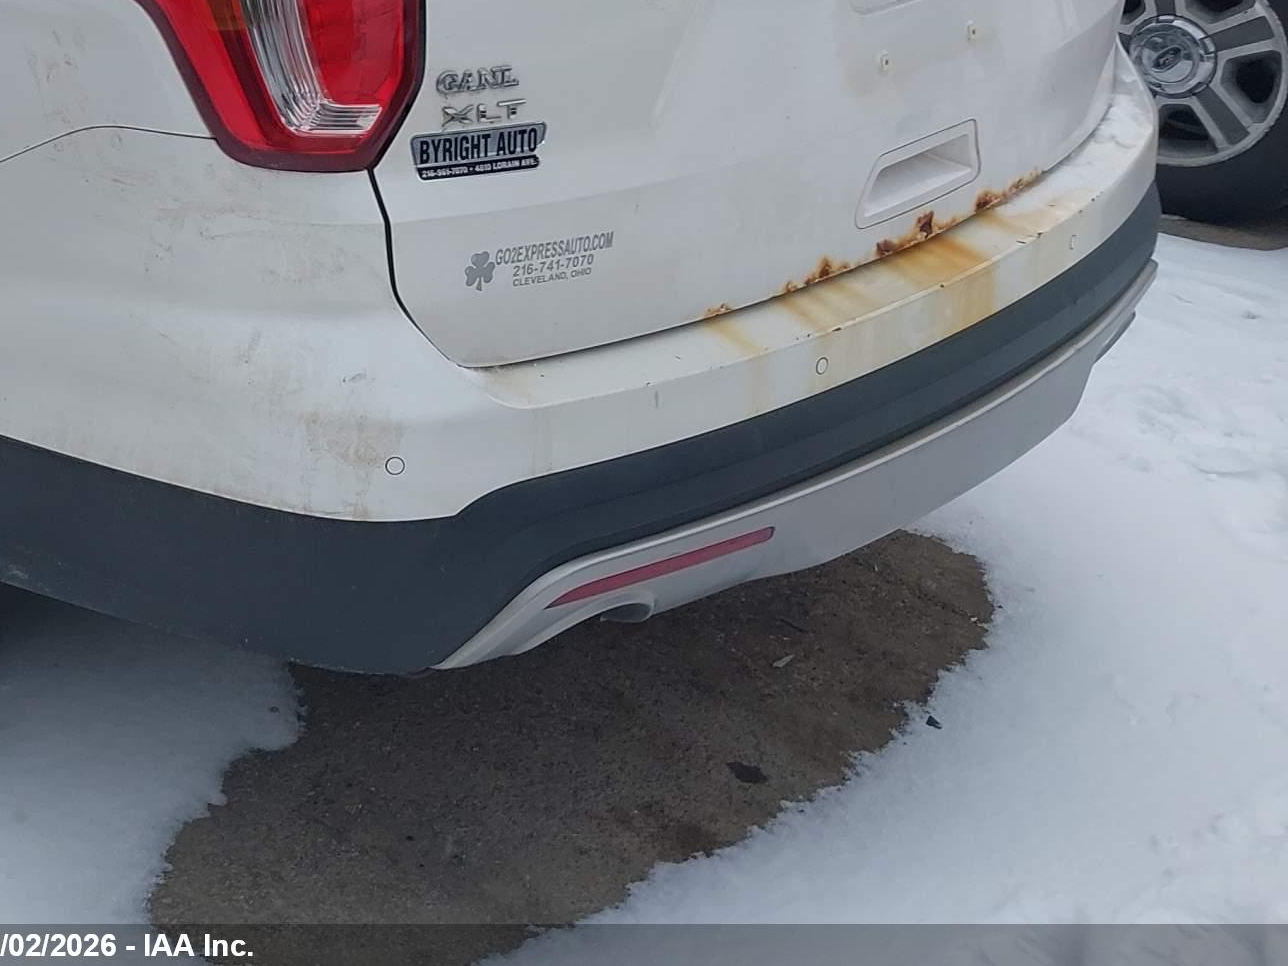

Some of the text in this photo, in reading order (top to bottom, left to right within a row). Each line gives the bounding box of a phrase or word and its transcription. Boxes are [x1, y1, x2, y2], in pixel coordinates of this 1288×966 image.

[442, 98, 527, 127] XLT
[419, 127, 537, 164] BYRIGHT AUTO
[492, 159, 520, 170] LORAIN
[495, 231, 615, 265] GO2EXPRESSAUTO.COM
[512, 253, 594, 277] 216-741-7070
[512, 267, 592, 287] CLEVELAND, OHIO
